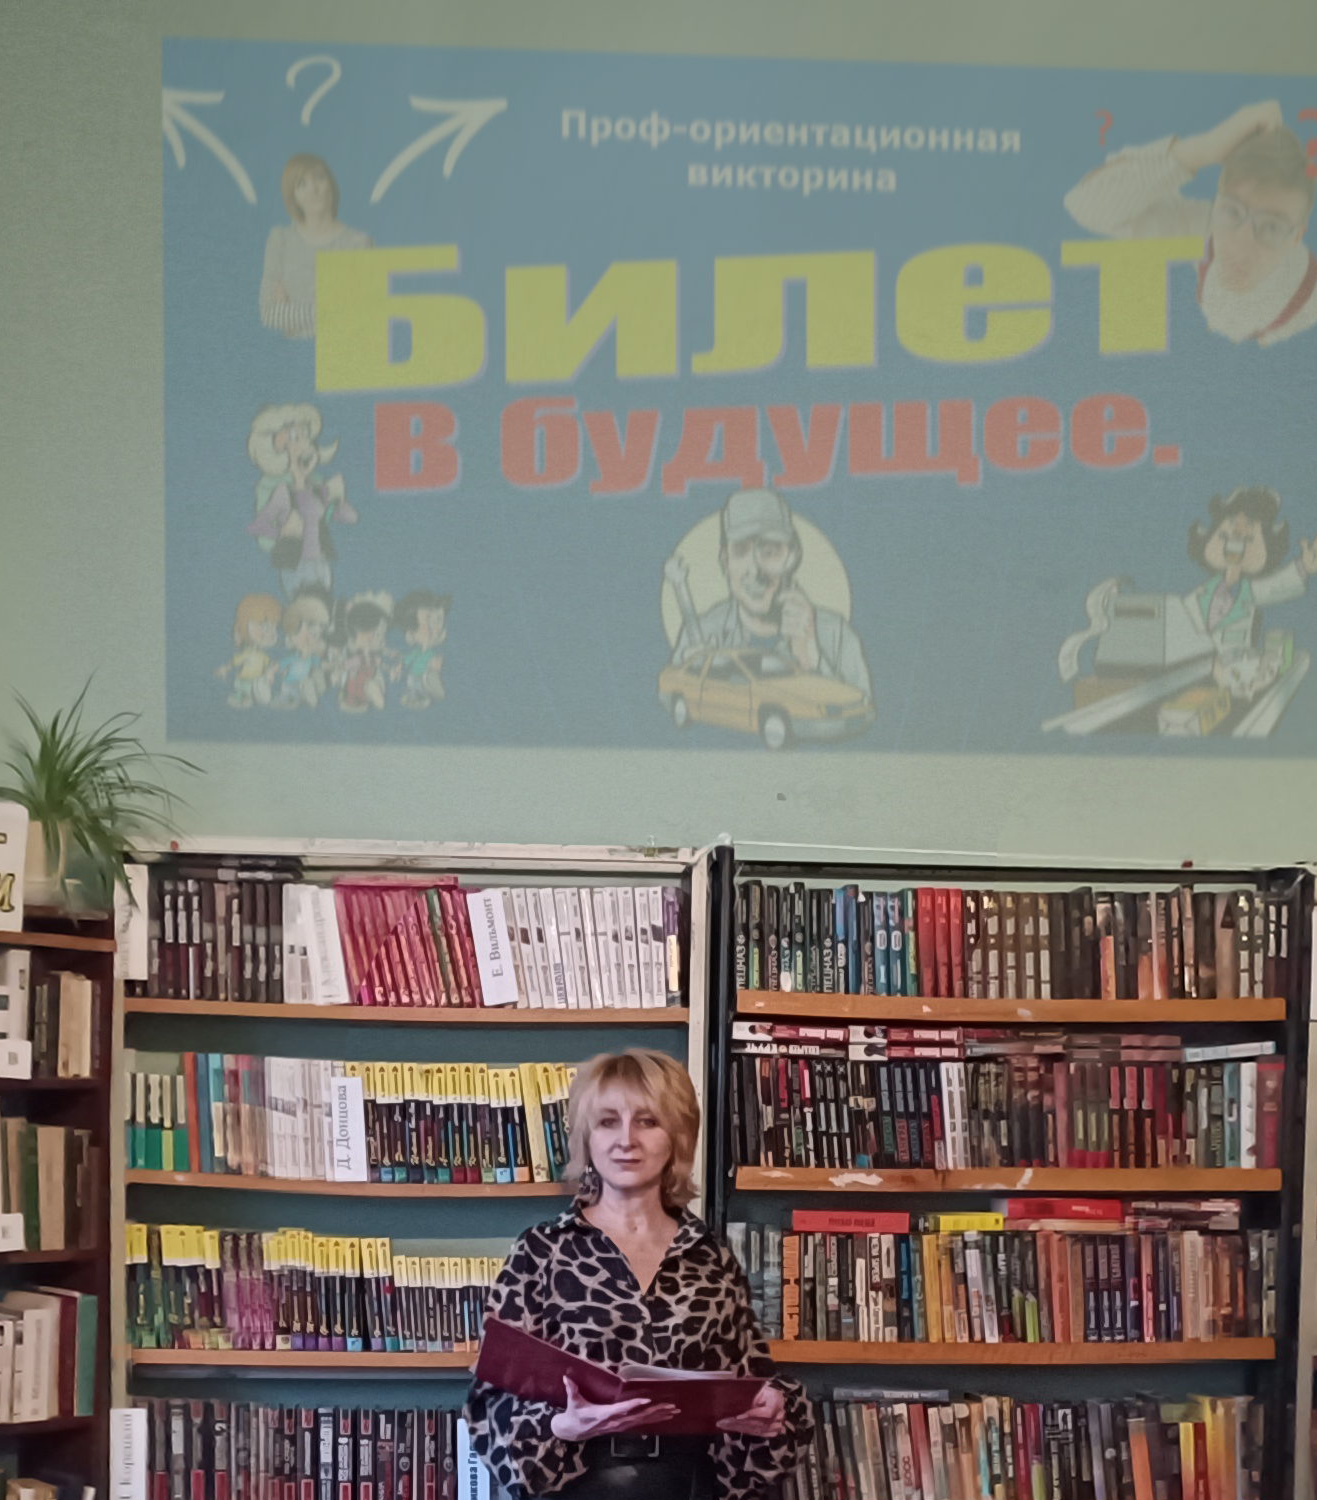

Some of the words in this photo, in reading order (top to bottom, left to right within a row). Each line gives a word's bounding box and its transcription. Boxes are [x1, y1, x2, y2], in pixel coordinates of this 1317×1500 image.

[561, 109, 1023, 154] Проф-ориентационная
[688, 159, 898, 195] викторина
[315, 237, 1204, 393] Билет
[499, 391, 1181, 498] будущее.
[482, 896, 503, 960] Вильмонт
[335, 1085, 351, 1150] Донцова
